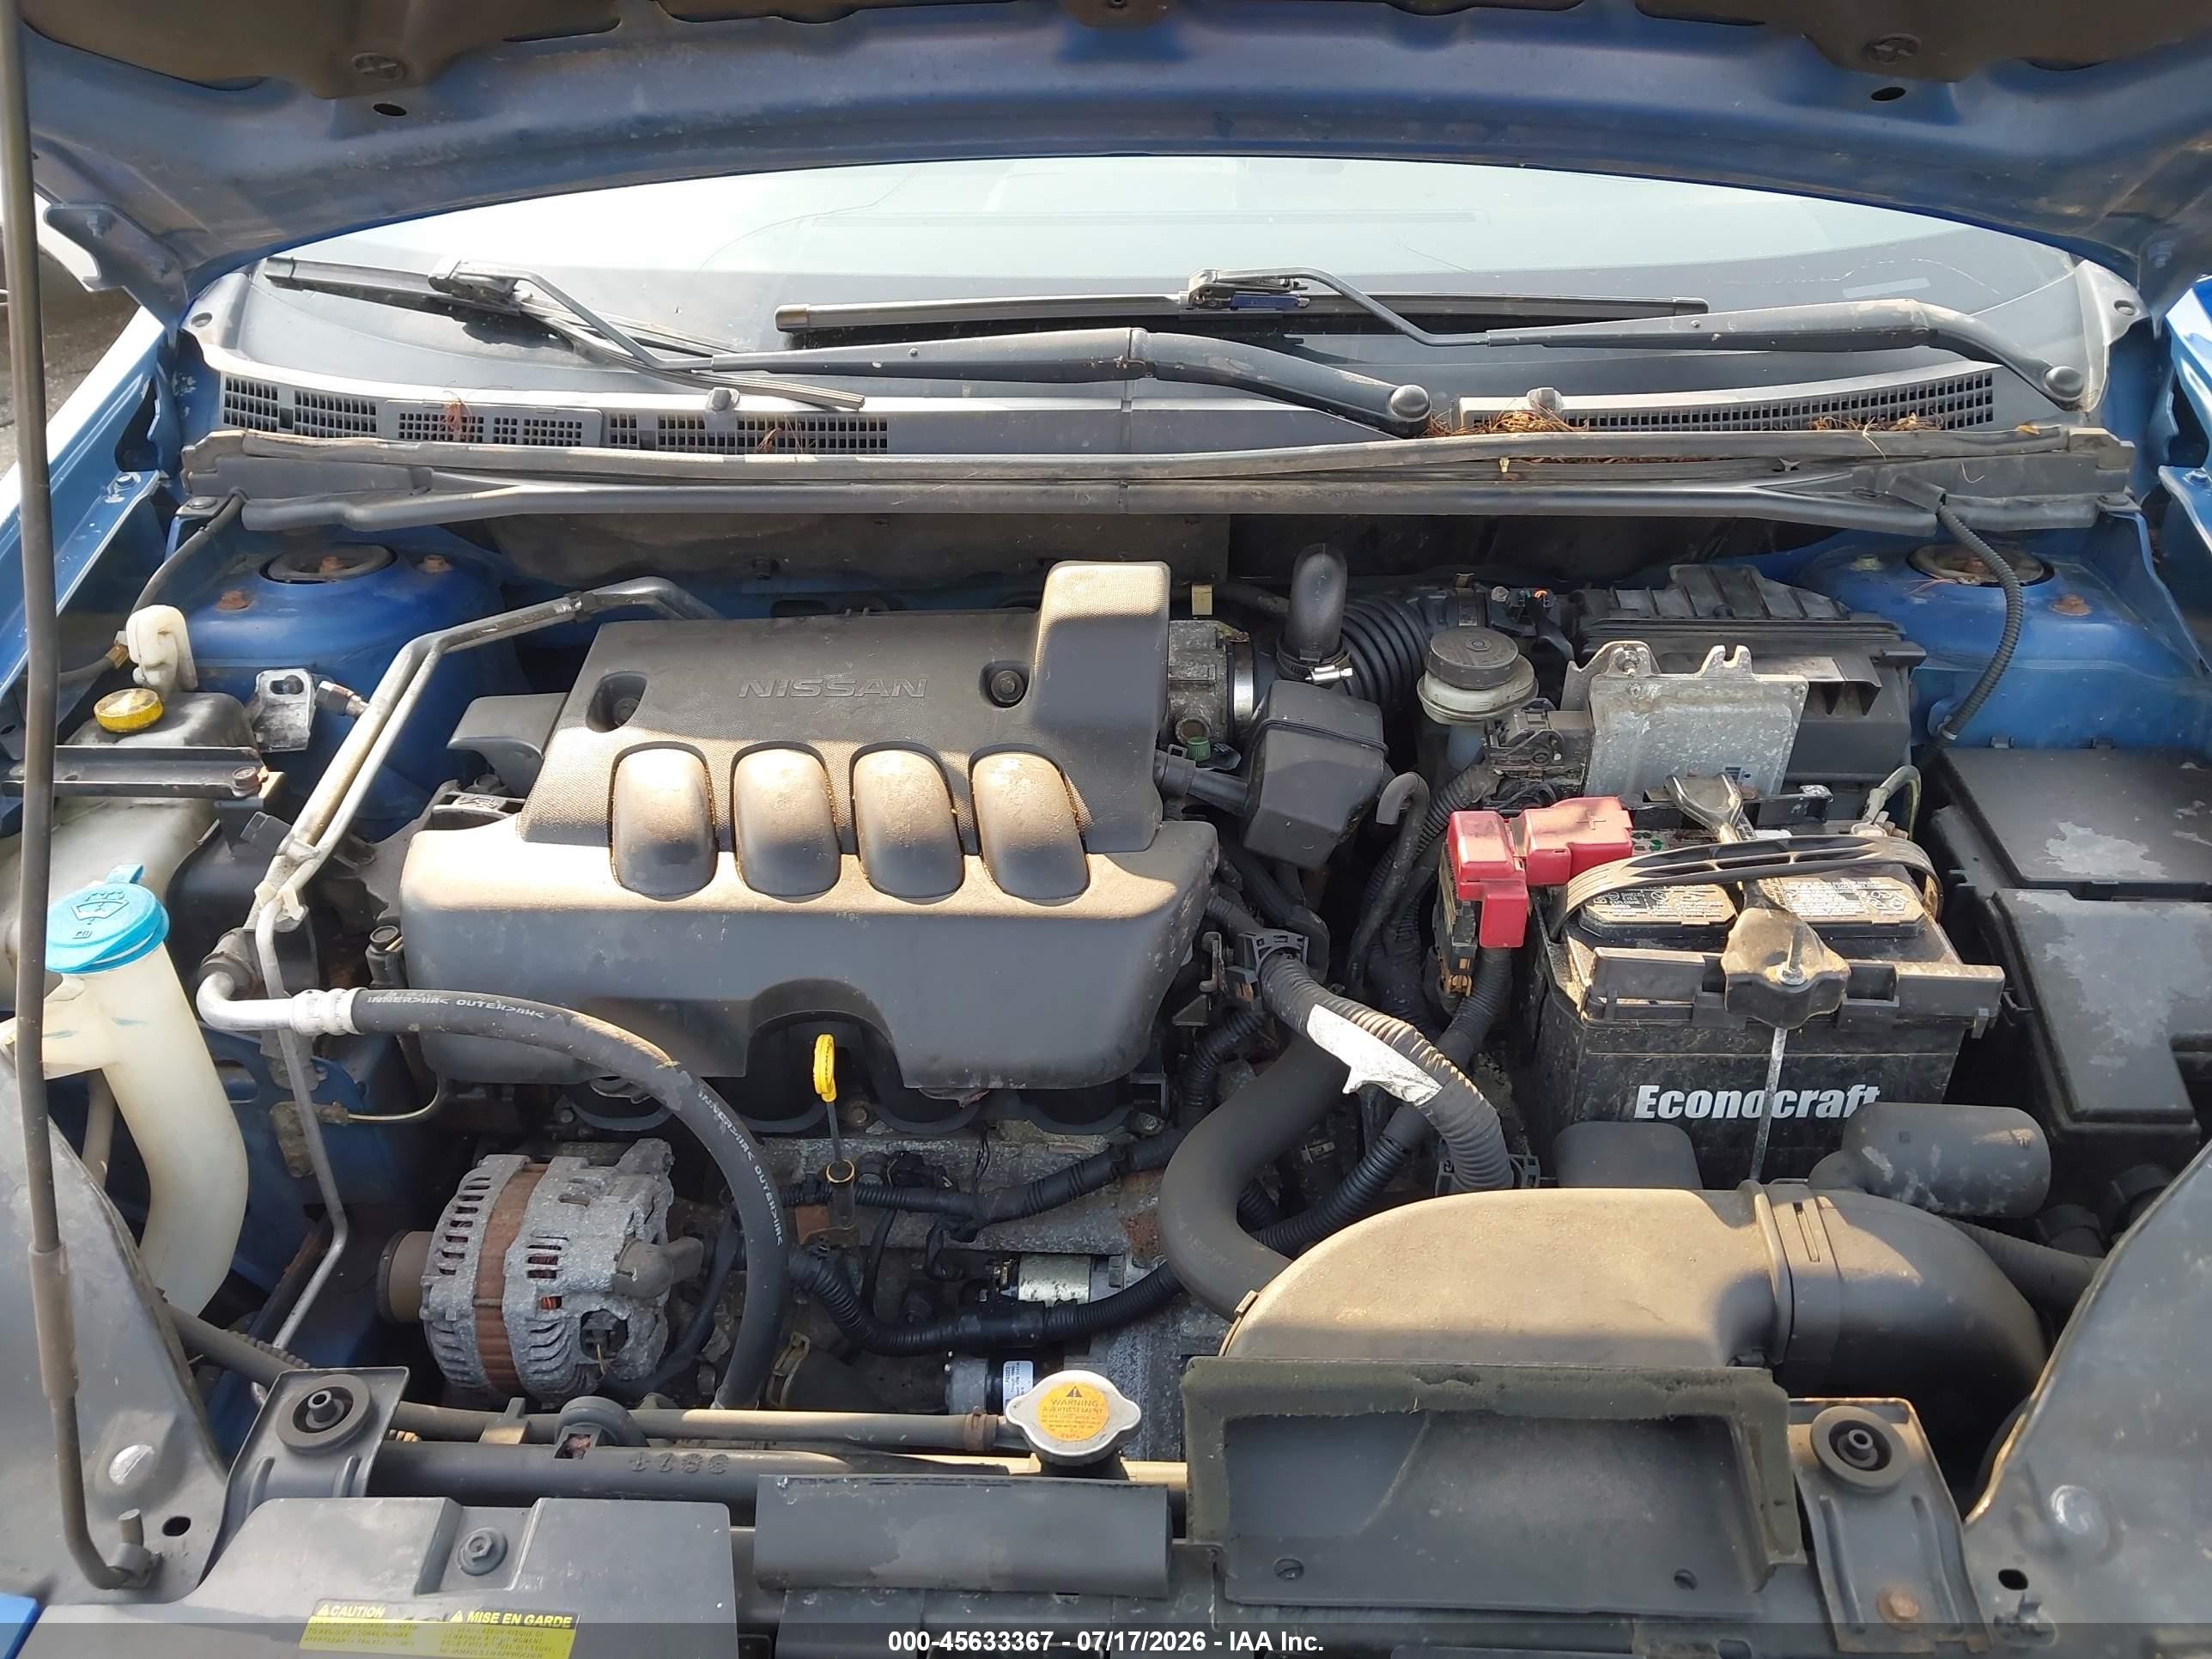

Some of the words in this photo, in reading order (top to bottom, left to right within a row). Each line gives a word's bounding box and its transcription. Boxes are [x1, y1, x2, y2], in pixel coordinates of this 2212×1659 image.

[738, 679, 927, 697] NISSAN
[1633, 1084, 1881, 1119] Econocraft
[1050, 1399, 1099, 1407] WARNING
[330, 1603, 386, 1619] CAUTION
[466, 1610, 501, 1624] MISE
[501, 1612, 522, 1626] EN
[523, 1613, 574, 1629] GARDE
